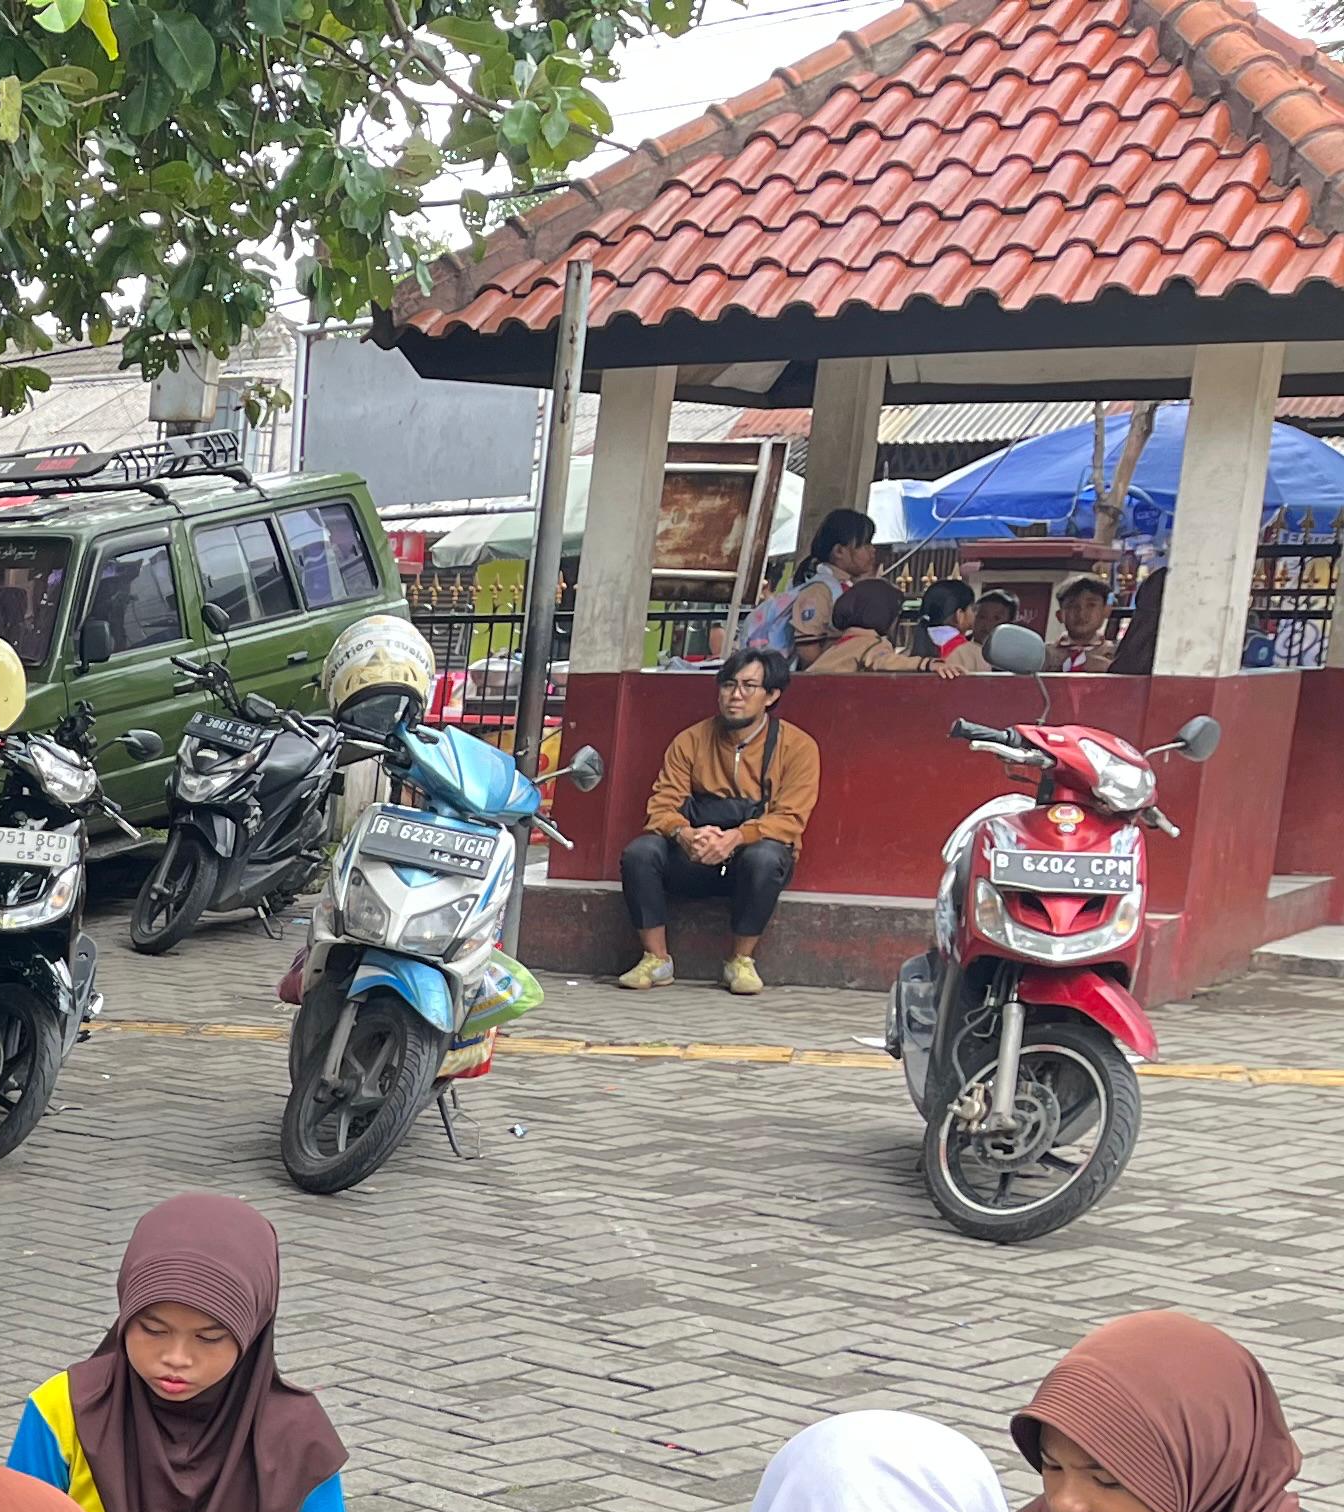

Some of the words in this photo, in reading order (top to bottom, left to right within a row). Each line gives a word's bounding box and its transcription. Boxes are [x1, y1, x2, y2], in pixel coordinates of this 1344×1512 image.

[36, 833, 67, 850] BCD
[376, 819, 390, 834] B
[399, 824, 446, 847] 6232
[996, 853, 1010, 868] B
[1022, 856, 1077, 874] 6404
[1090, 859, 1132, 876] CPN
